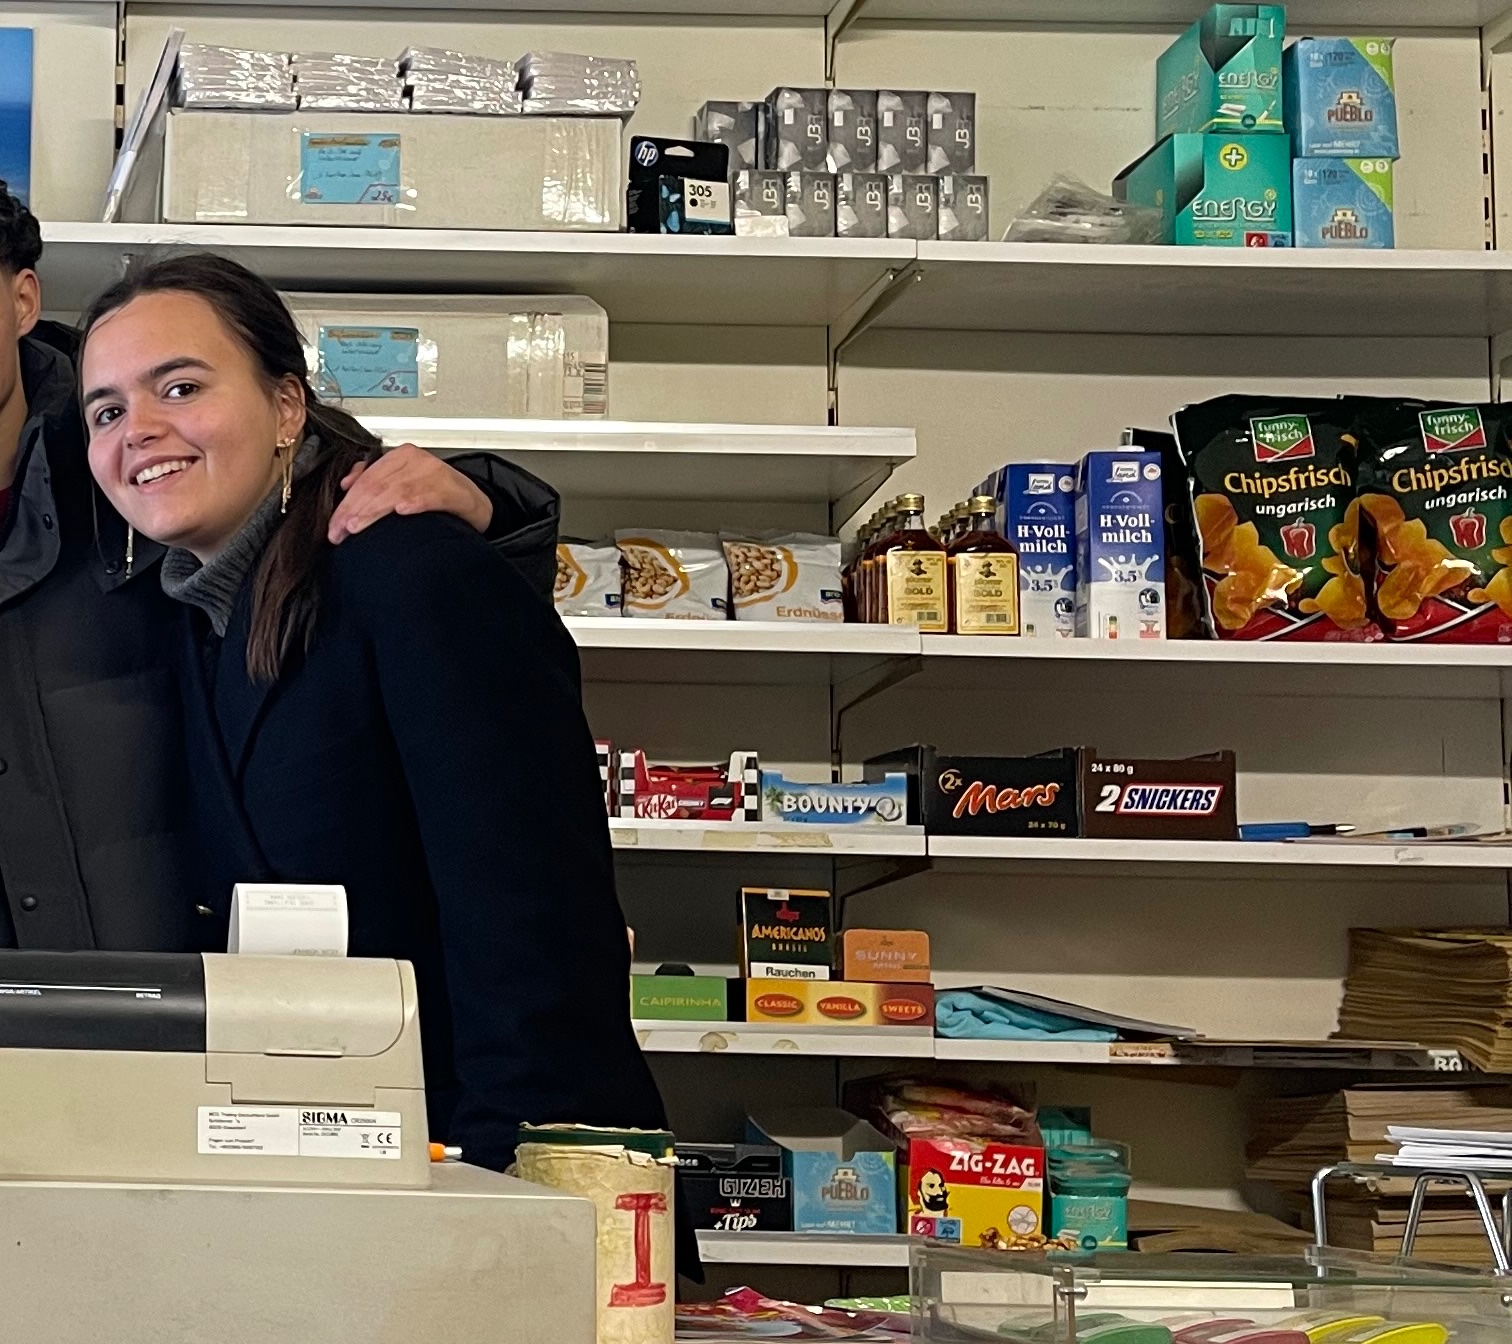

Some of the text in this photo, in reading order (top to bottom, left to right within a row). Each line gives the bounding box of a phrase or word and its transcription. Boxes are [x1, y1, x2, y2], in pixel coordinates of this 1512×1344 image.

[1327, 103, 1373, 123] PUEBLO
[637, 141, 656, 166] hp
[689, 184, 712, 197] 305
[1321, 221, 1368, 240] PUEBLO
[1257, 420, 1299, 434] funny-
[1426, 413, 1471, 426] funny-
[1434, 421, 1474, 436] frisch
[1224, 464, 1352, 499] Chipsfrisch
[1392, 457, 1512, 492] Chipsfrisc
[1425, 485, 1508, 511] ungarisch
[1255, 494, 1336, 519] ungarisch
[1099, 513, 1155, 528] H-Voll-
[1017, 525, 1070, 539] H-Voll-
[1101, 529, 1152, 543] milch
[1019, 539, 1068, 554] milch
[1091, 763, 1103, 773] 24
[1126, 766, 1134, 775] g
[944, 772, 963, 790] 2x
[640, 794, 678, 818] KitKat
[782, 795, 872, 816] BOUNTY
[952, 781, 1060, 819] Mars
[1095, 785, 1217, 812] 2 SNICKERS
[752, 923, 826, 942] AMERICANOS
[855, 950, 917, 961] SUNNY
[766, 966, 816, 979] Rauchen
[639, 997, 722, 1007] CAIPIRINHA
[757, 999, 798, 1009] CLASSIC
[819, 1002, 861, 1012] VANILLA
[882, 1006, 923, 1014] SWEETS
[302, 1111, 348, 1125] SIGMA
[949, 1151, 1035, 1177] ZIG-ZAG
[719, 1177, 786, 1198] GIZEH
[821, 1180, 869, 1201] PUEBLO
